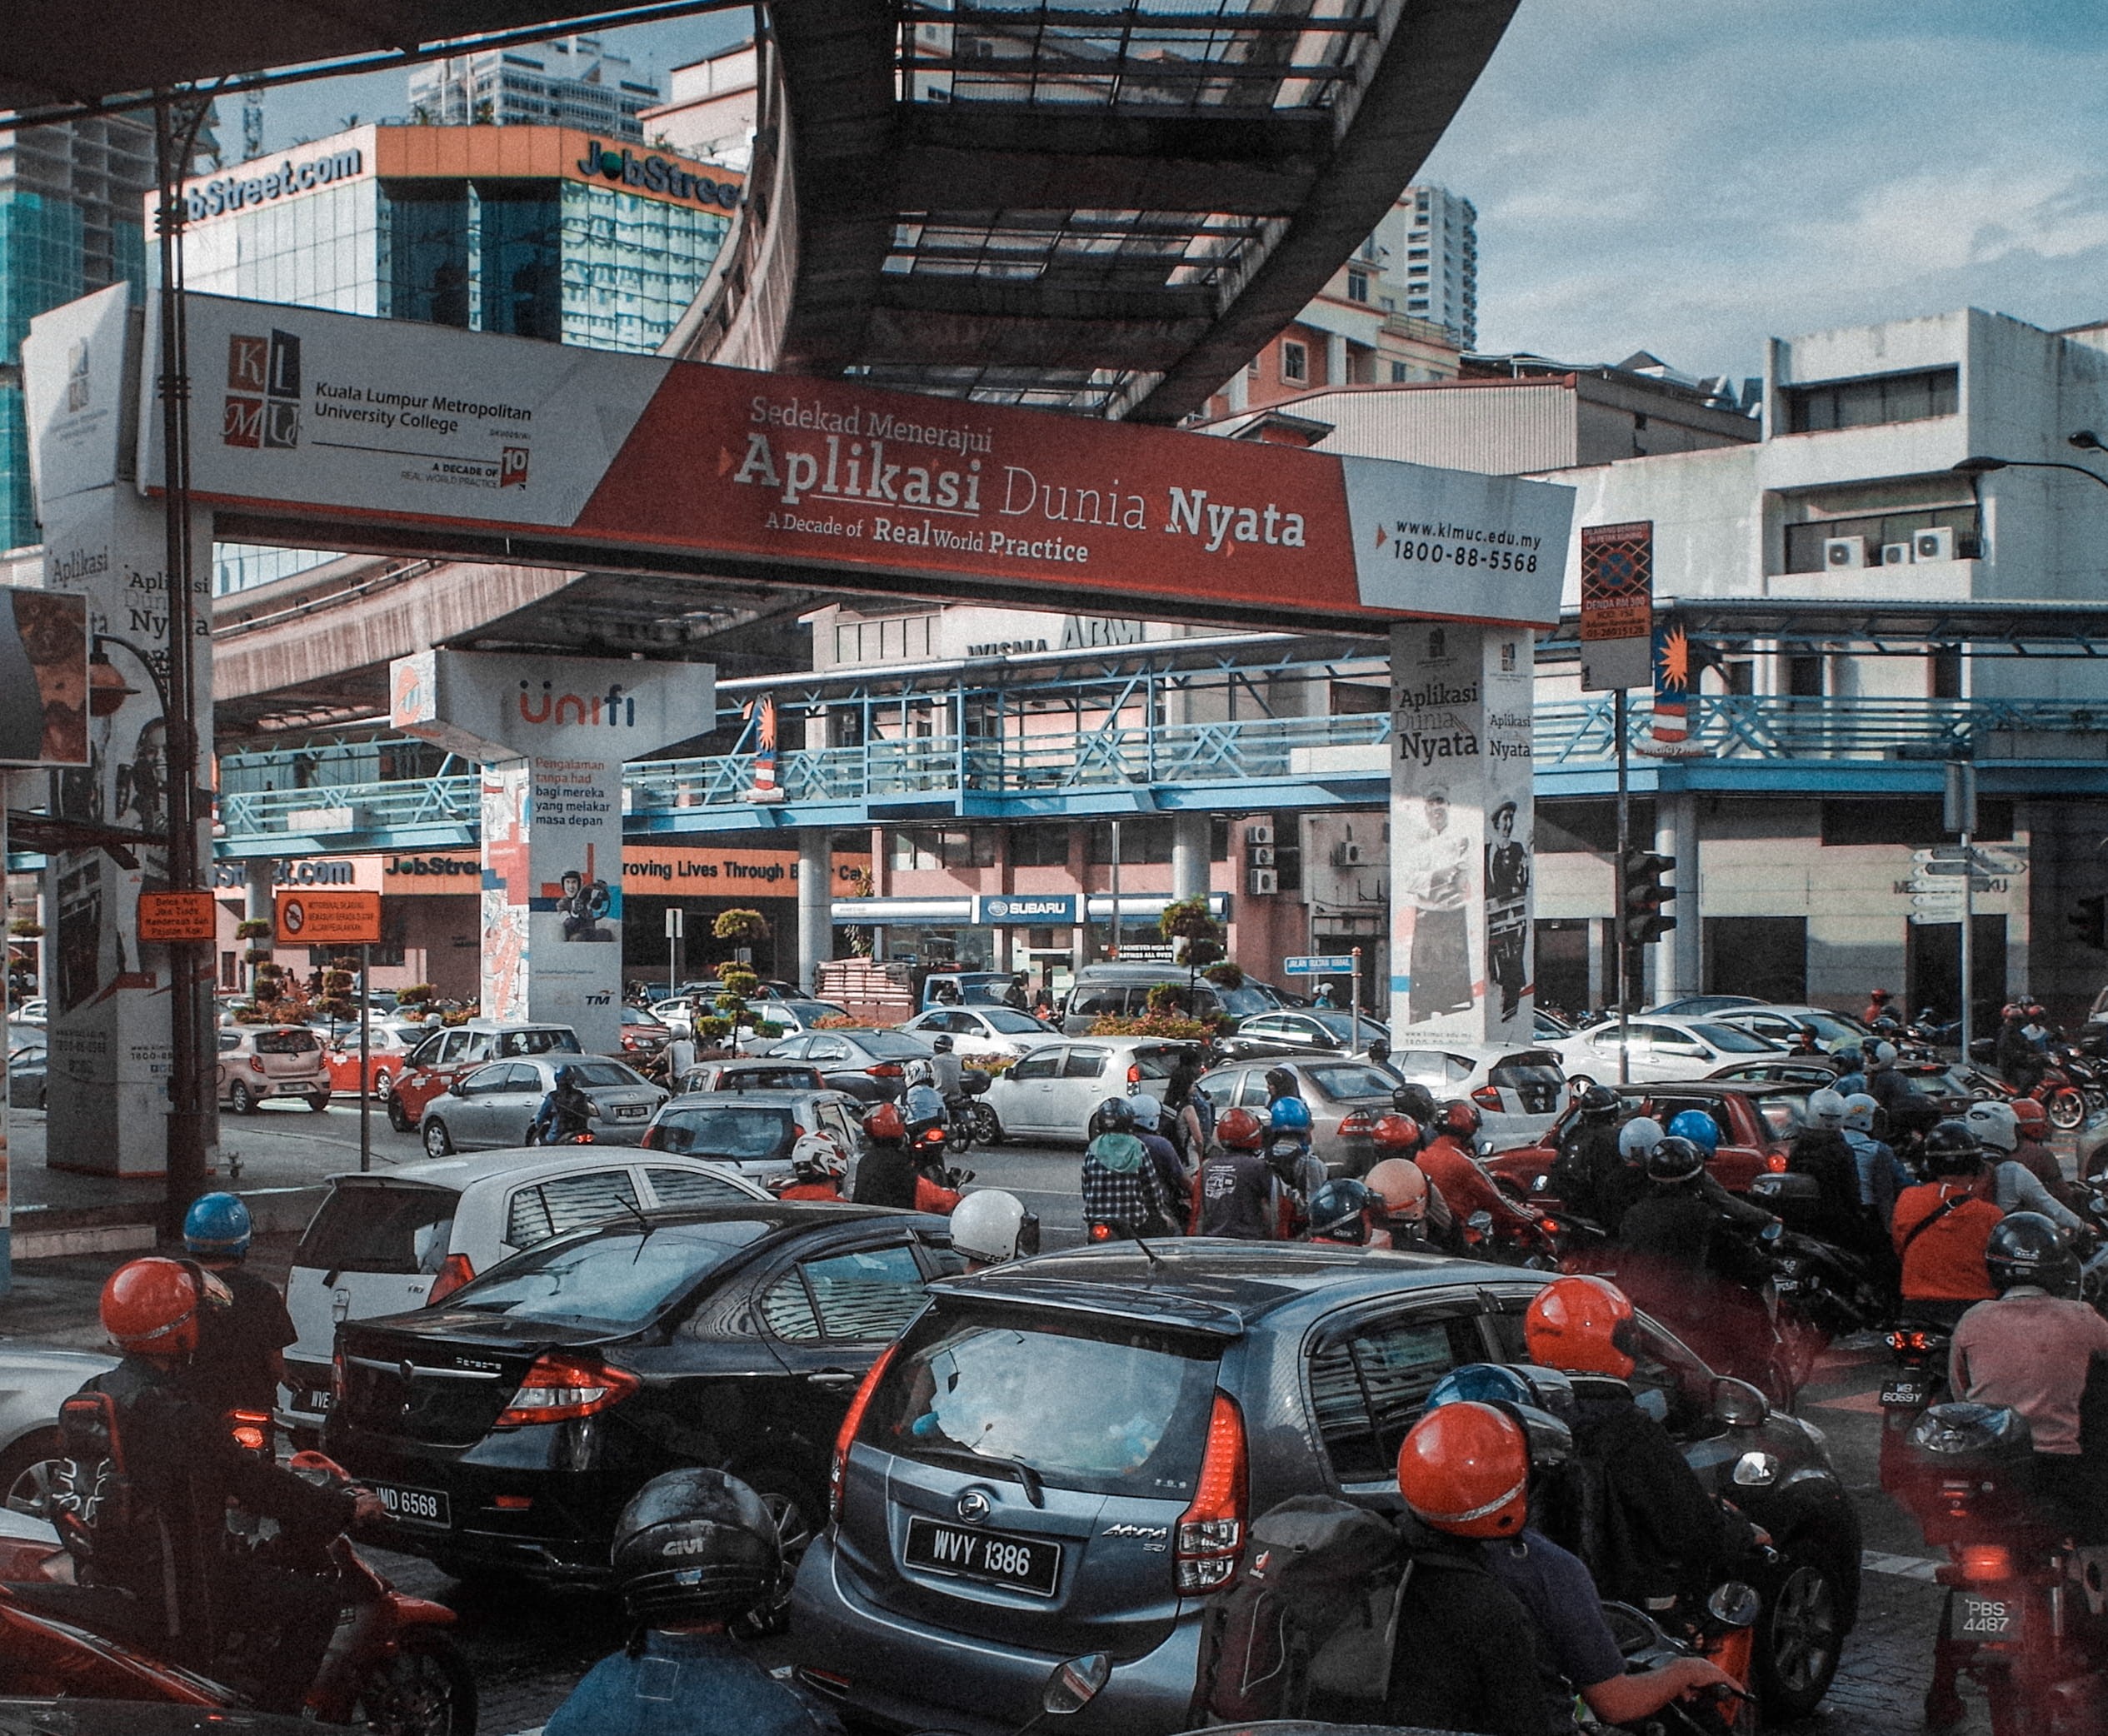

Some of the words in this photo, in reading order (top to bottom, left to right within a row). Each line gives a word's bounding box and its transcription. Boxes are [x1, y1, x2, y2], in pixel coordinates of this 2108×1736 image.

[187, 147, 362, 222] bStreet.com
[577, 140, 742, 209] JobStree
[316, 382, 362, 402] Kuala
[367, 386, 428, 411] Lumpur
[432, 397, 532, 421] Metropolitan
[315, 402, 395, 429] University
[400, 412, 458, 433] College
[750, 396, 859, 435] Sedekad
[868, 412, 993, 456] Menerajui
[425, 473, 457, 485] WORLD
[458, 476, 497, 488] PRACTICE
[432, 463, 440, 472] A
[443, 463, 482, 476] DECADE
[485, 466, 498, 477] OF
[734, 432, 980, 511] Aplikasi
[999, 466, 1146, 531] Dunia
[1165, 486, 1306, 551] Nyata
[765, 511, 780, 529] A
[783, 513, 842, 536] Decade
[847, 519, 864, 538] of
[873, 517, 930, 546] Real
[933, 528, 983, 551] World
[988, 531, 1089, 563] Practice
[1396, 520, 1541, 551] www.klmuc.edu.my
[52, 546, 108, 586] Aplikasi
[1394, 540, 1538, 573] 1800-88-5568
[129, 571, 210, 594] Aplisi
[1586, 599, 1615, 610] DENDA
[1400, 681, 1478, 712] Aplikasi
[1490, 714, 1531, 729] Aplikasi
[1400, 731, 1479, 766] Nyata
[1490, 740, 1531, 761] Nyata
[536, 757, 605, 771] Pengalaman
[536, 774, 567, 785] tanpa
[571, 772, 592, 784] had
[536, 785, 560, 800] bagi
[563, 787, 604, 798] mereka
[536, 802, 563, 814] yang
[566, 801, 611, 812] melakar
[536, 816, 566, 825] masa
[568, 815, 603, 827] depan
[623, 860, 672, 879] roving
[677, 861, 718, 877] Lives
[723, 861, 784, 882] Through
[1009, 902, 1066, 915] SUBARU
[585, 995, 610, 1005] TM
[402, 1492, 437, 1517] 6568
[662, 1538, 704, 1556] GIVI
[933, 1529, 977, 1564] WVY
[984, 1541, 1031, 1576] 1386
[1969, 1601, 2006, 1617] PBS
[1963, 1617, 2010, 1632] 4487
